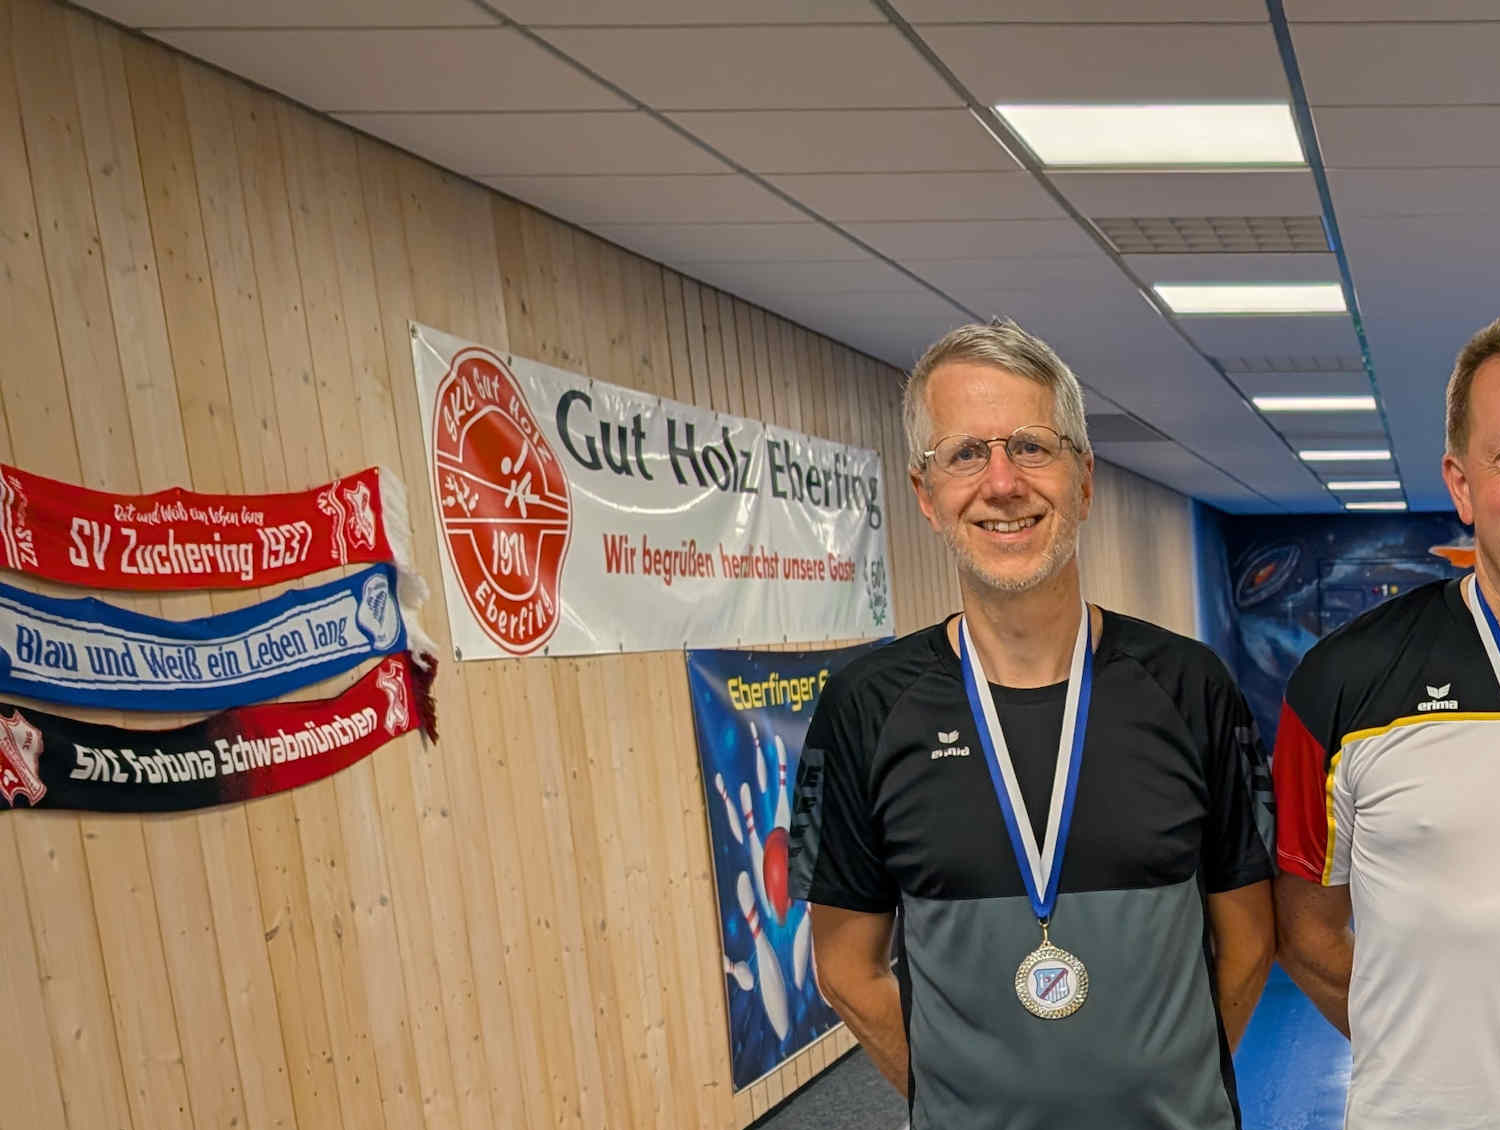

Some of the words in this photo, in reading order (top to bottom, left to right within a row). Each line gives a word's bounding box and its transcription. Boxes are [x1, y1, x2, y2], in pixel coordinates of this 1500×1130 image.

[444, 375, 476, 442] SKC
[473, 367, 500, 403] Gut
[556, 389, 654, 481] Gut
[666, 416, 759, 494] Holz
[767, 439, 882, 530] Eberfing
[16, 526, 39, 568] SVZ
[69, 517, 112, 571] SV
[120, 528, 254, 581] Zuchering
[257, 520, 313, 570] 1937
[492, 529, 530, 577] 1971
[602, 533, 637, 574] Wir
[641, 534, 716, 587] begrüßen
[719, 542, 780, 580] herzlichst
[782, 552, 825, 582] unsere
[475, 580, 555, 640] Eberfing
[16, 624, 79, 672] Blau
[85, 642, 140, 678] und
[139, 643, 204, 682] Weiß
[207, 645, 243, 679] ein
[244, 629, 308, 671] Leben
[306, 615, 349, 650] lang
[727, 672, 817, 712] Eberfinger
[1417, 699, 1459, 712] erima
[120, 749, 217, 785] Fortuna
[214, 706, 379, 776] Schwabmünchen
